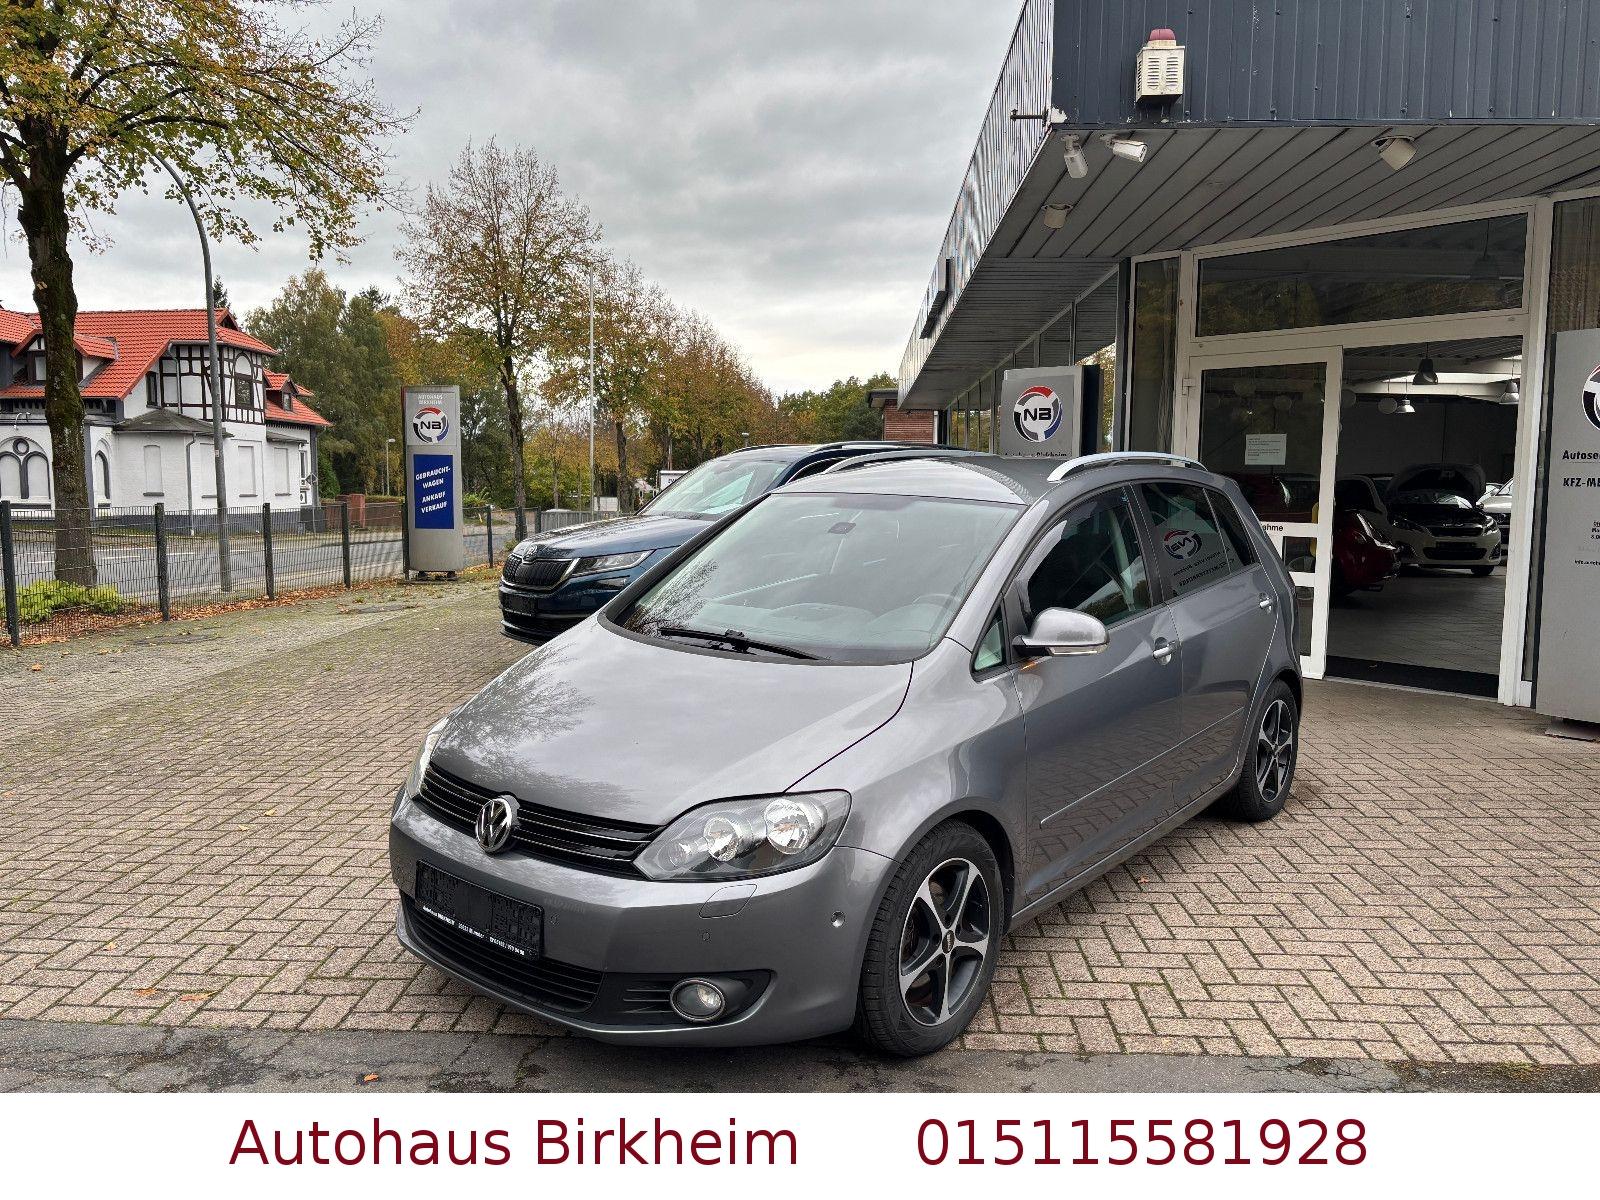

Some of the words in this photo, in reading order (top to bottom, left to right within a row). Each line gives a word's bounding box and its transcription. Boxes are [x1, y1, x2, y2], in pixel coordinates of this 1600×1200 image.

[1023, 407, 1052, 421] NB
[420, 420, 442, 430] NB
[1562, 450, 1600, 460] Autose
[415, 465, 451, 480] GEBRAUCHT-
[422, 478, 444, 489] WAGEN
[422, 491, 446, 503] ANKAUF
[421, 501, 447, 513] VERKAUF
[1261, 523, 1284, 532] ahme
